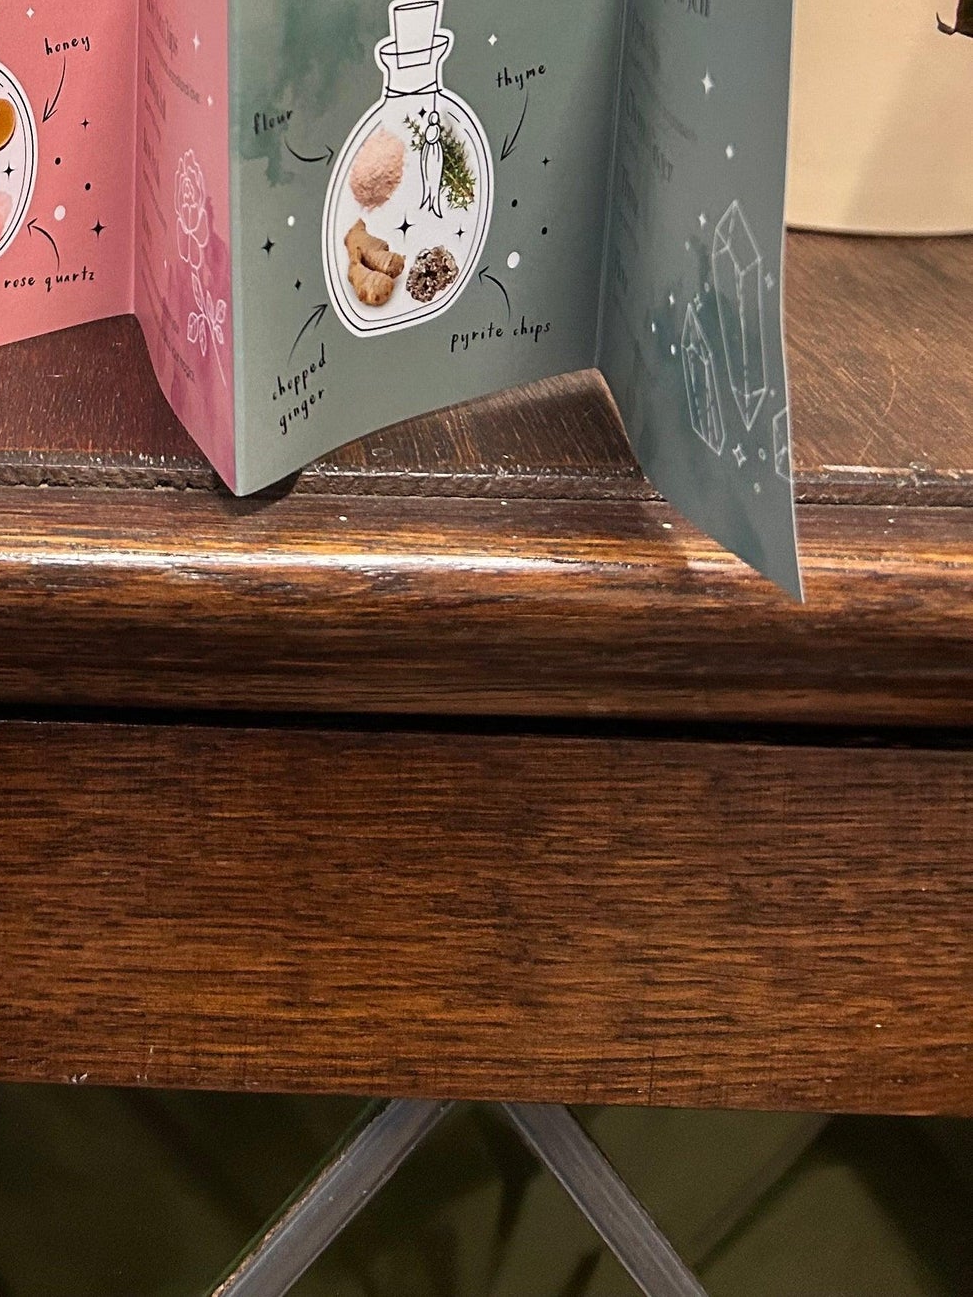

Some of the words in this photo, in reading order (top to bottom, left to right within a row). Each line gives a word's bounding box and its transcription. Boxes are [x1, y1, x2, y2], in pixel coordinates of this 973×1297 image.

[45, 36, 90, 55] honey
[495, 65, 546, 91] thyme
[253, 109, 293, 135] flour
[4, 277, 35, 288] rose
[45, 266, 94, 292] quartz
[451, 322, 503, 353] pyrite
[513, 316, 550, 343] chips
[273, 342, 326, 401] chopped
[280, 389, 325, 436] ginger
